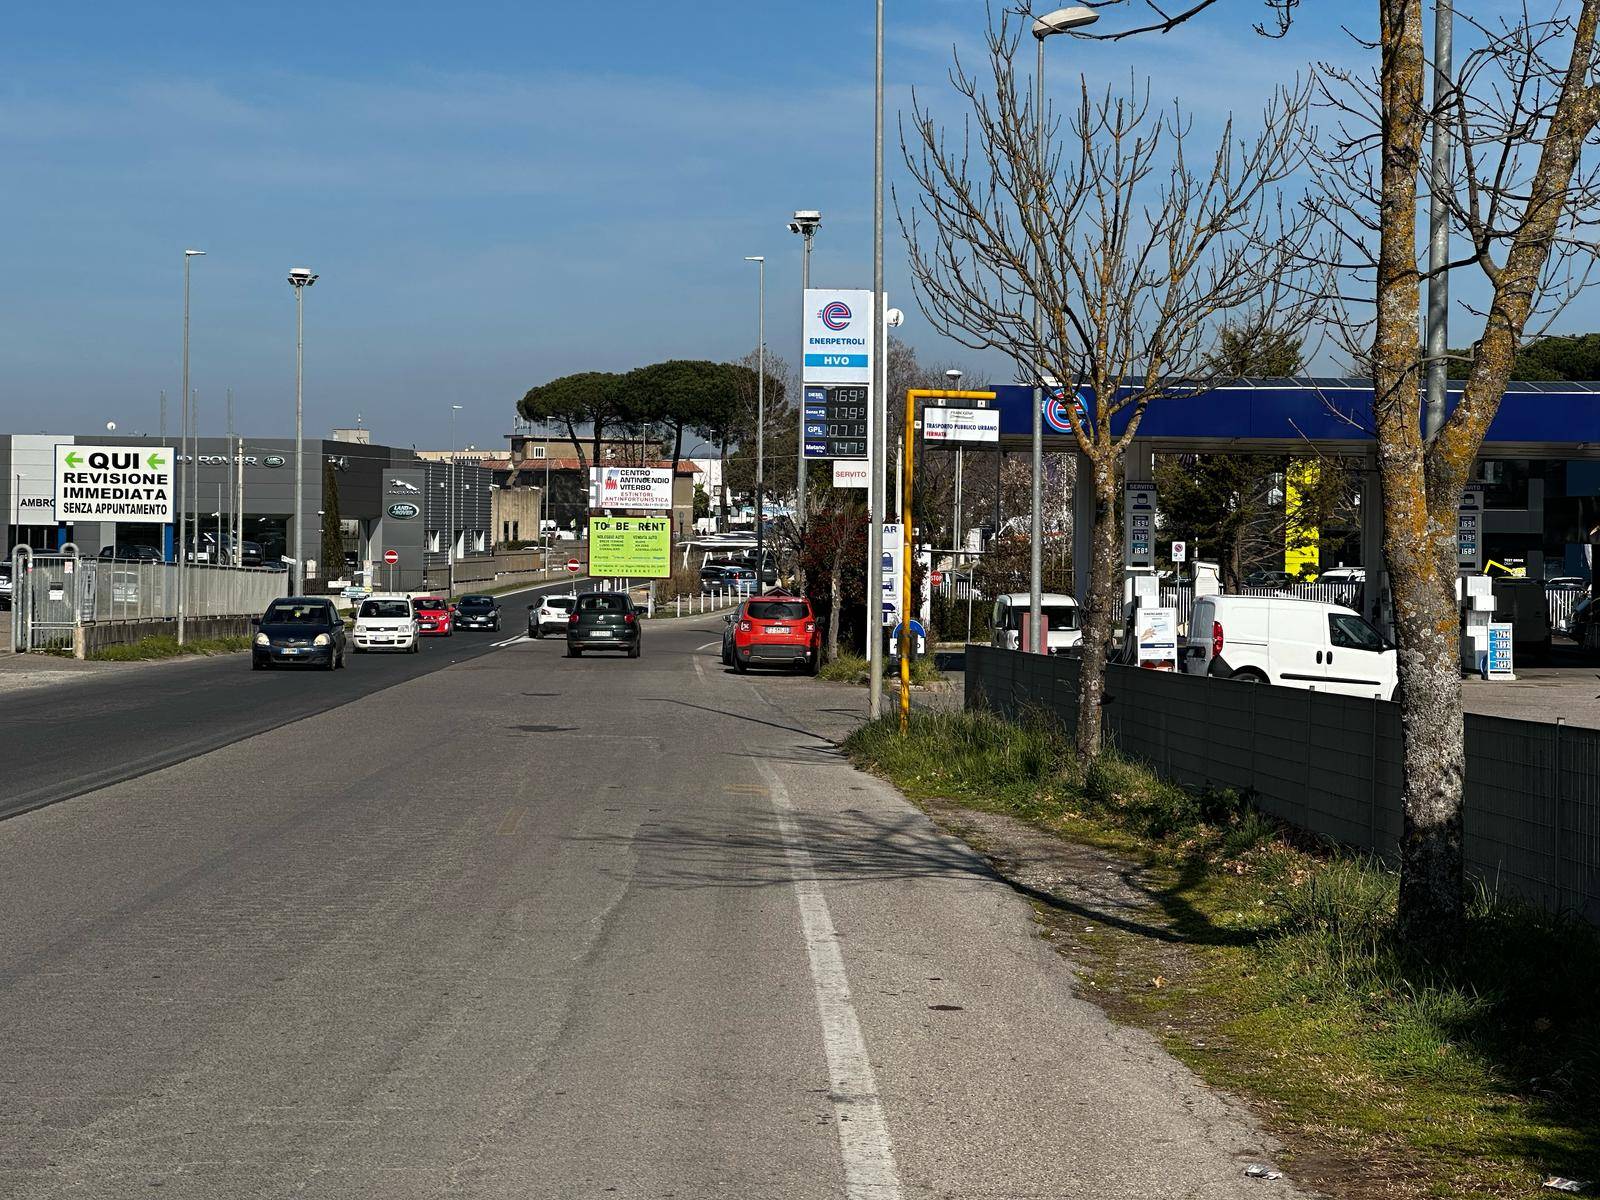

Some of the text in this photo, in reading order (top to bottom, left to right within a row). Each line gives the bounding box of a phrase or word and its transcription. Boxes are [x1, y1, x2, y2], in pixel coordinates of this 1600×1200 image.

[824, 356, 849, 365] HVO
[88, 452, 139, 470] QUI
[198, 455, 258, 466] ROVER
[64, 473, 167, 485] REVISIONE
[64, 487, 167, 500] IMMEDIATA
[63, 503, 167, 515] SENZA APPUNTAMENTO
[594, 522, 666, 531] TO BE RENT
